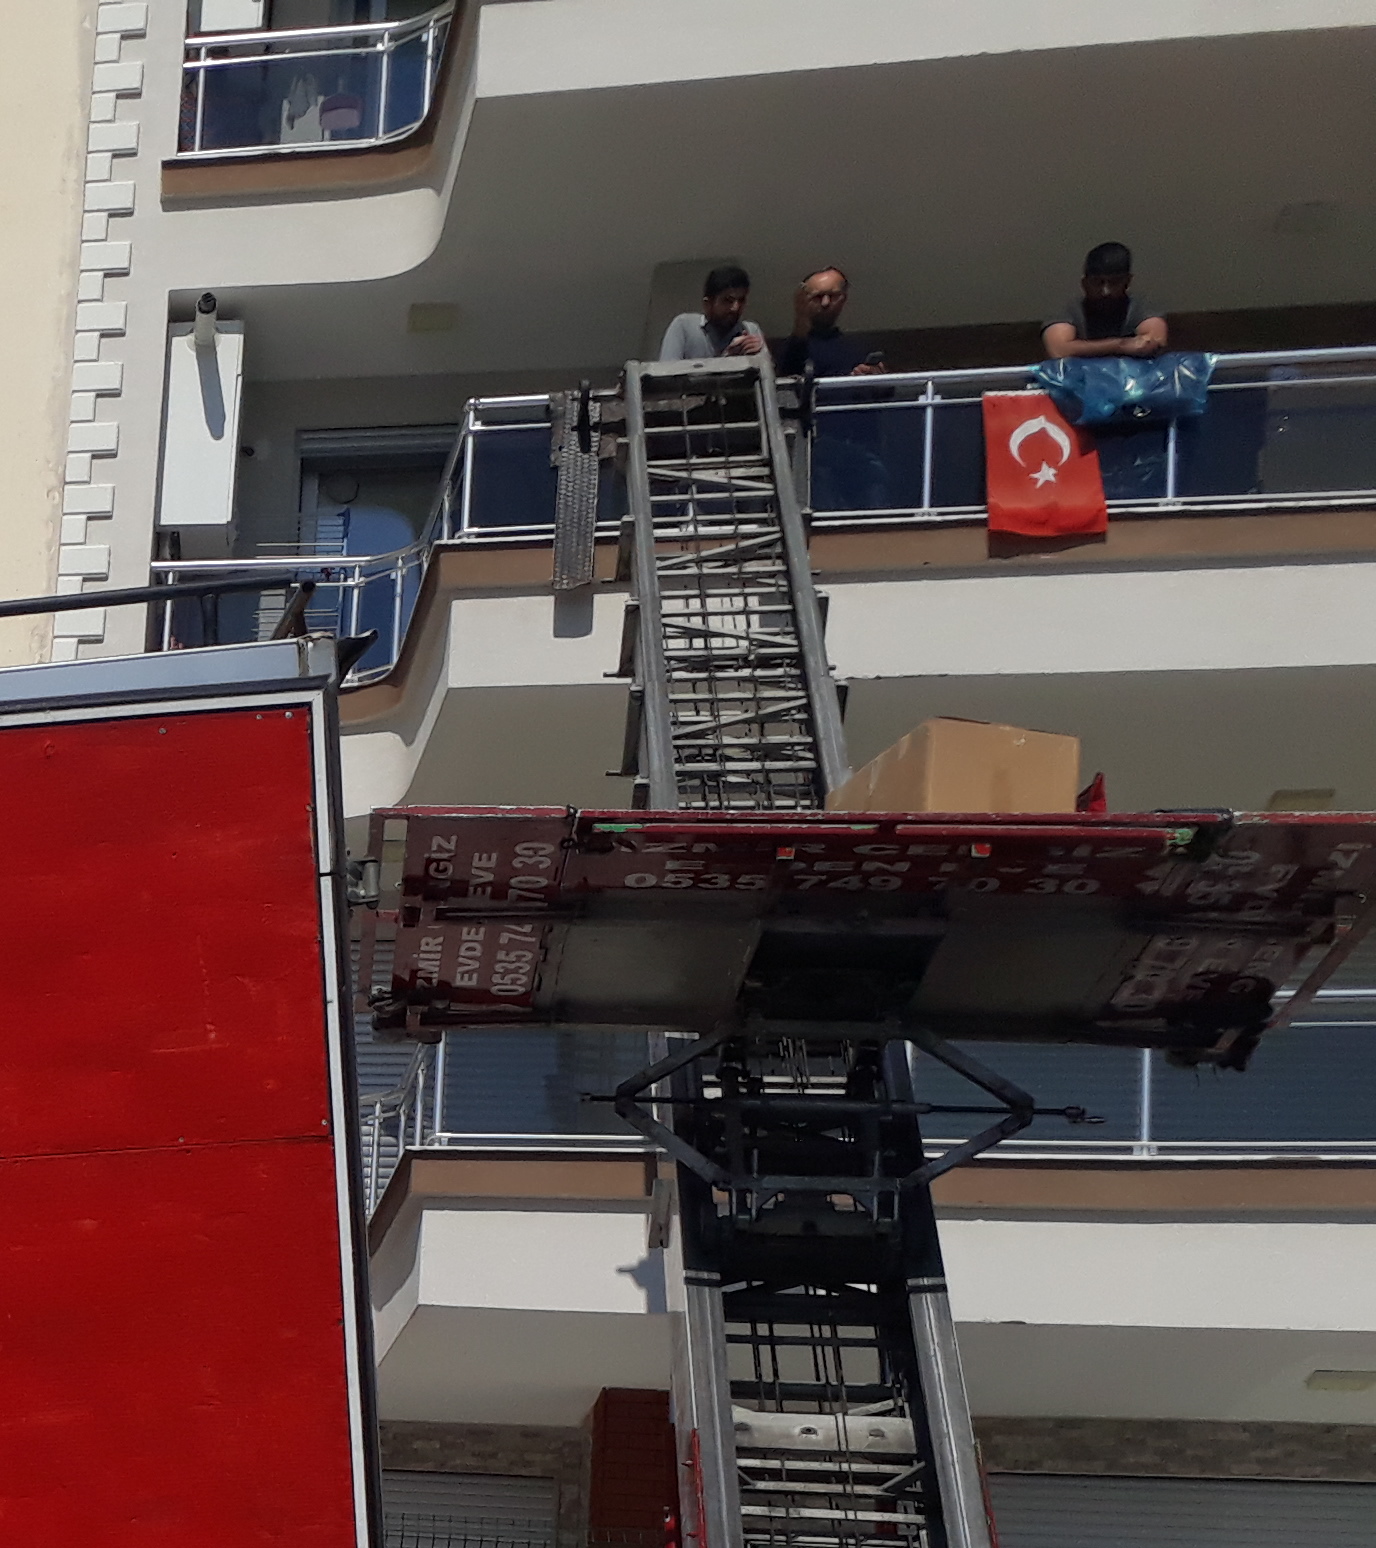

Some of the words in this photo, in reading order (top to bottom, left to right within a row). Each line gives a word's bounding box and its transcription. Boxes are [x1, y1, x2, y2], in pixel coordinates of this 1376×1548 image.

[623, 873, 769, 890] 0535
[793, 874, 903, 892] 749
[1023, 878, 1101, 895] 30
[490, 949, 536, 996] 0535
[514, 841, 555, 870] 30
[413, 936, 443, 988] ZMİR
[455, 924, 486, 986] EVDE
